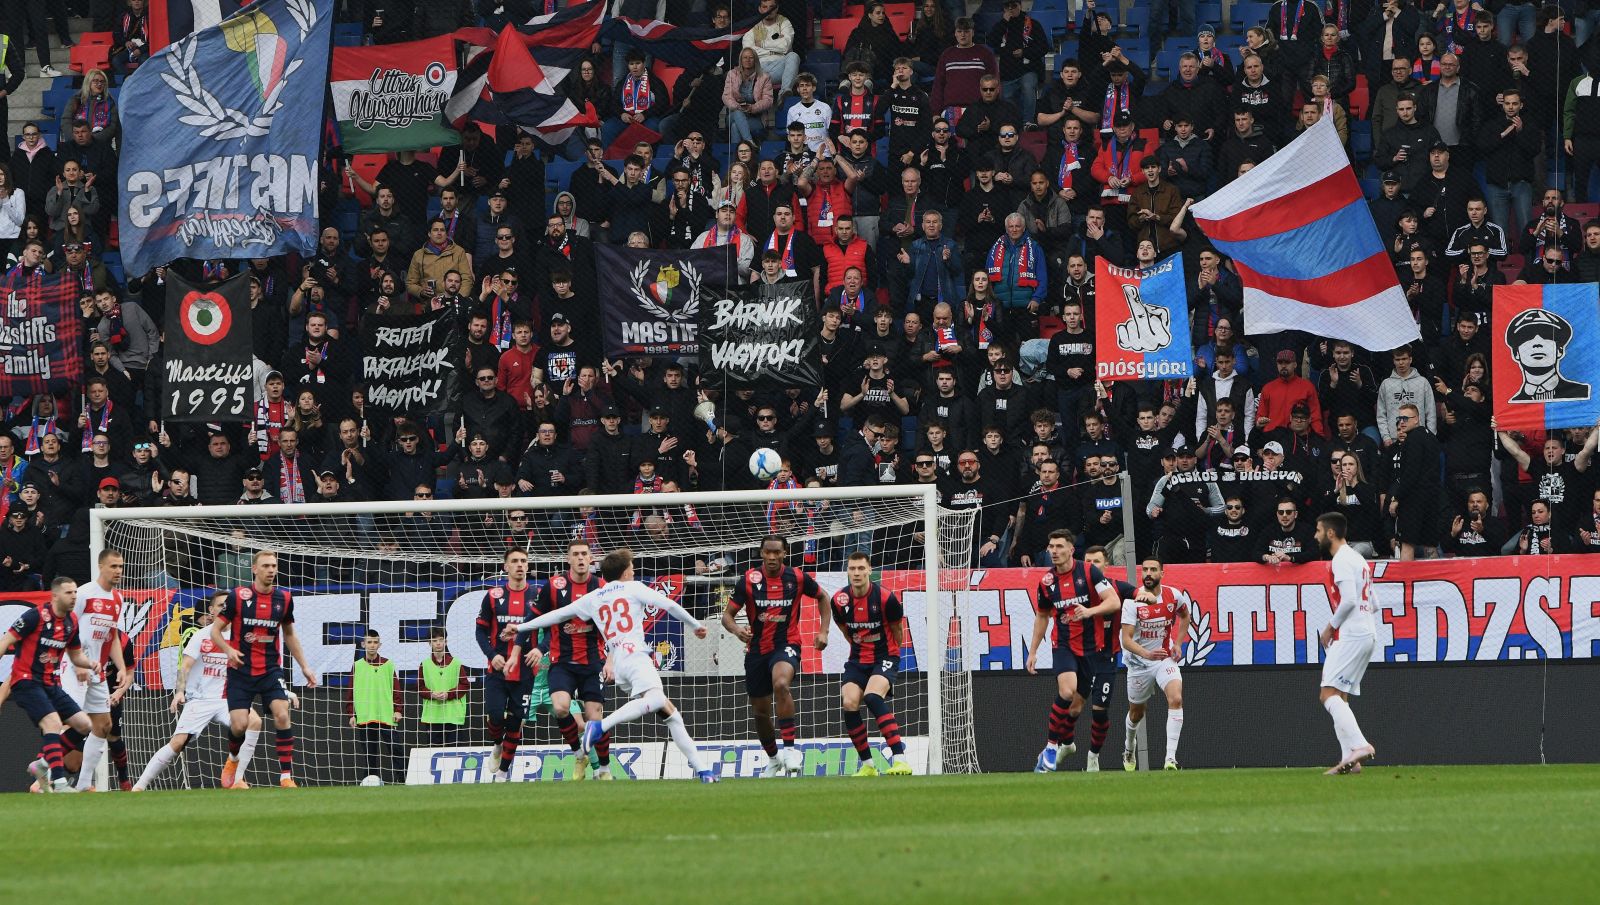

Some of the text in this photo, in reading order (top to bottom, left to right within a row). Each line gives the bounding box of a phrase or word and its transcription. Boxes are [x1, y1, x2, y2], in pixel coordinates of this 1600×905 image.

[165, 358, 253, 385] Mastiffs
[548, 358, 576, 367] ULTRAS
[171, 386, 246, 416] 1995
[598, 598, 633, 641] 23
[1140, 629, 1159, 639] HELL
[1102, 682, 1110, 694] 6
